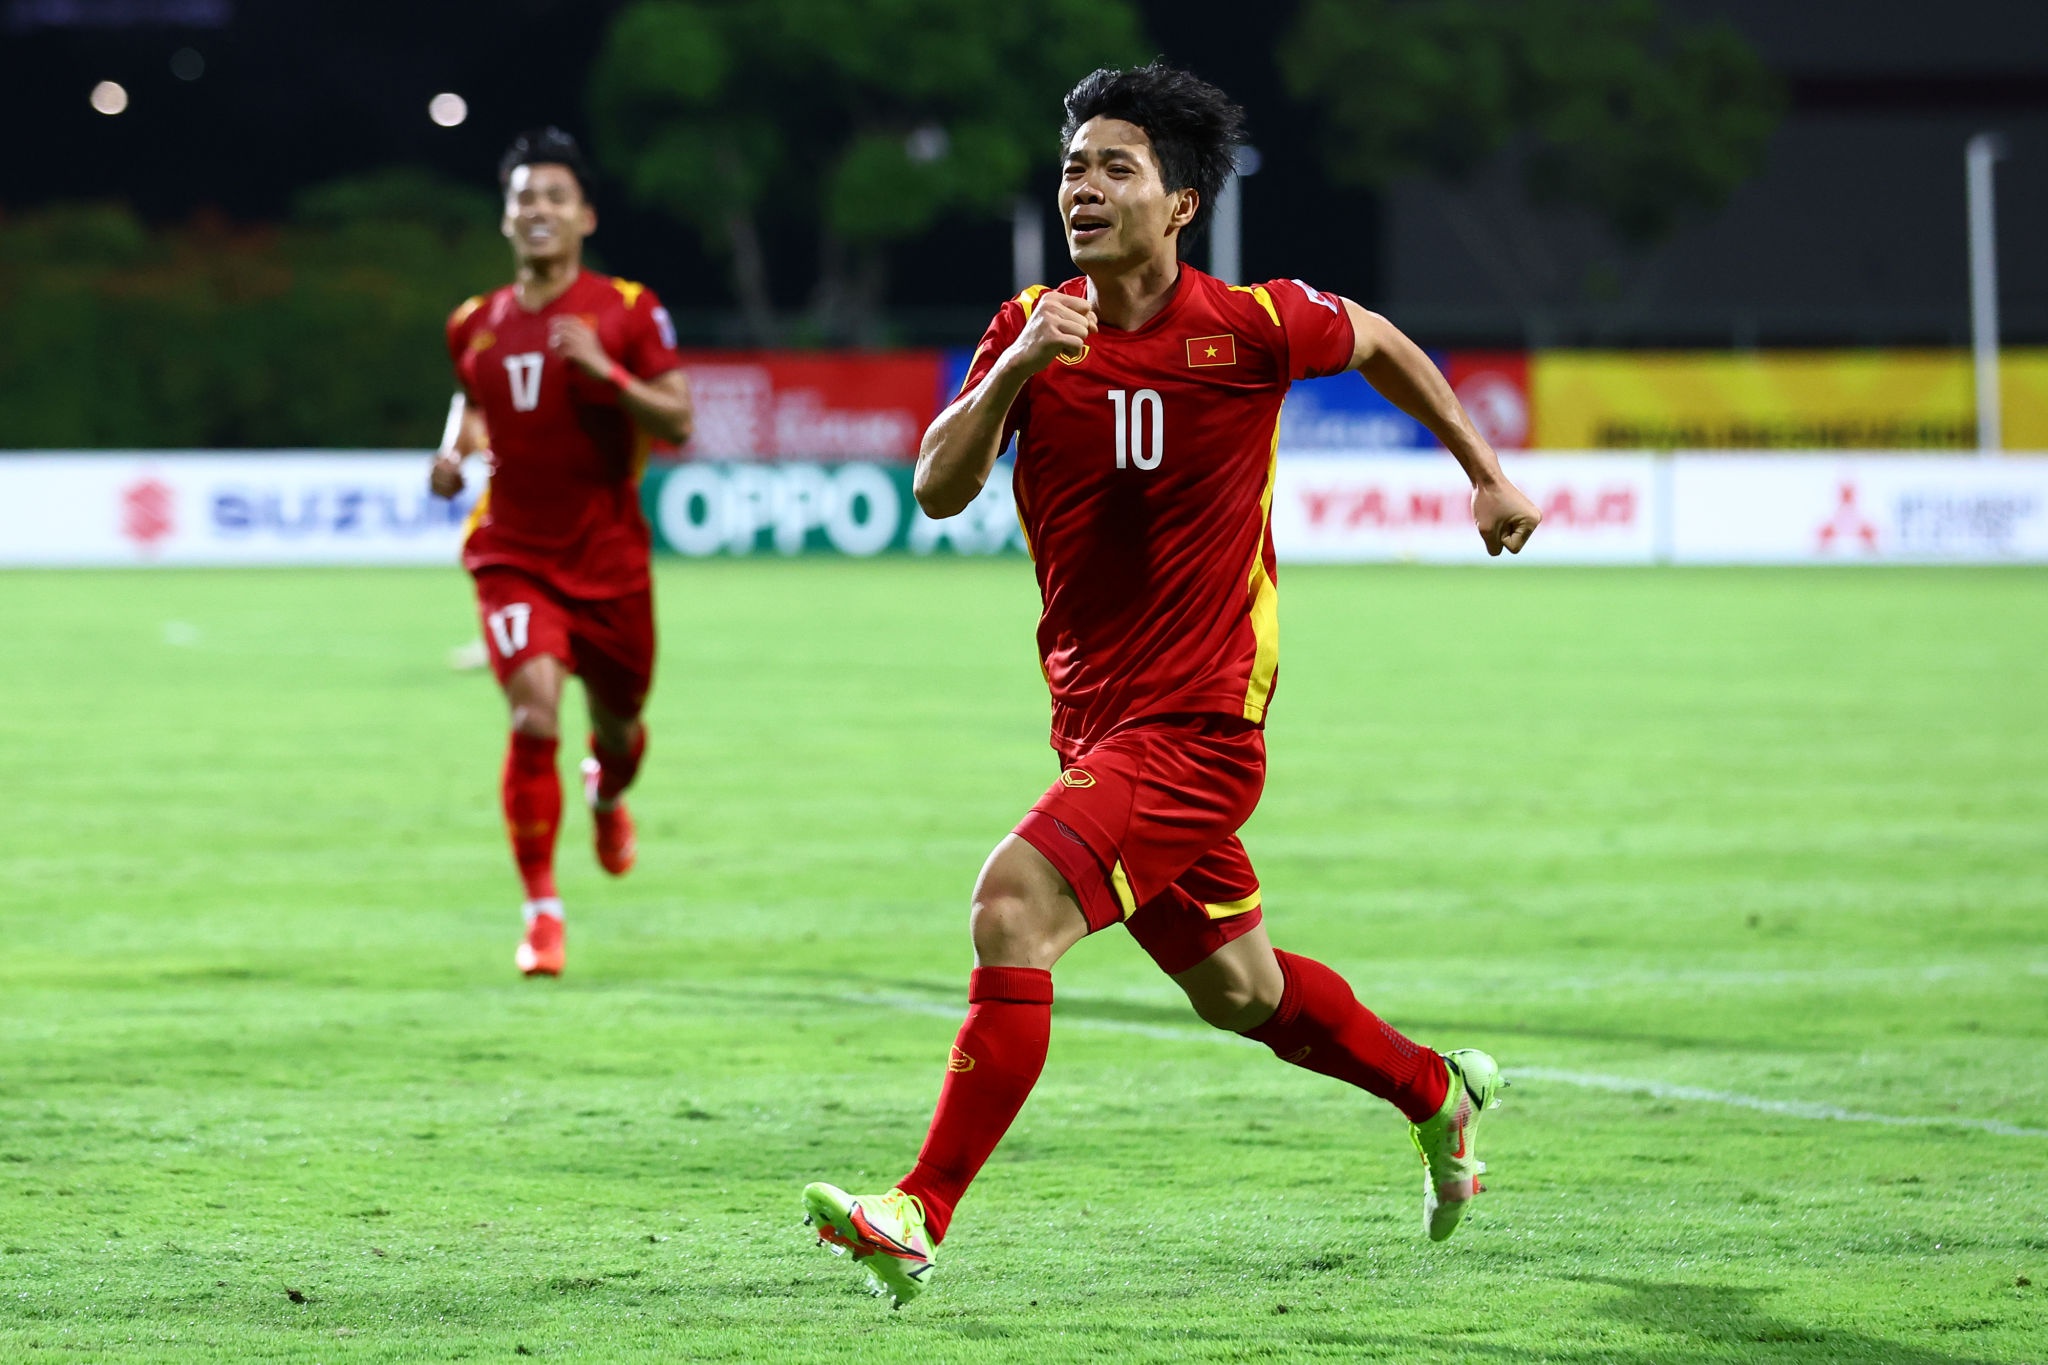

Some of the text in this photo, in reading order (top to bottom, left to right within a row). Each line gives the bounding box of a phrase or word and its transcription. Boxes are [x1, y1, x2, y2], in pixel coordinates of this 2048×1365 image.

[503, 352, 545, 412] 17
[1107, 388, 1164, 471] 10
[657, 461, 898, 557] OPPO
[488, 602, 532, 658] 17
